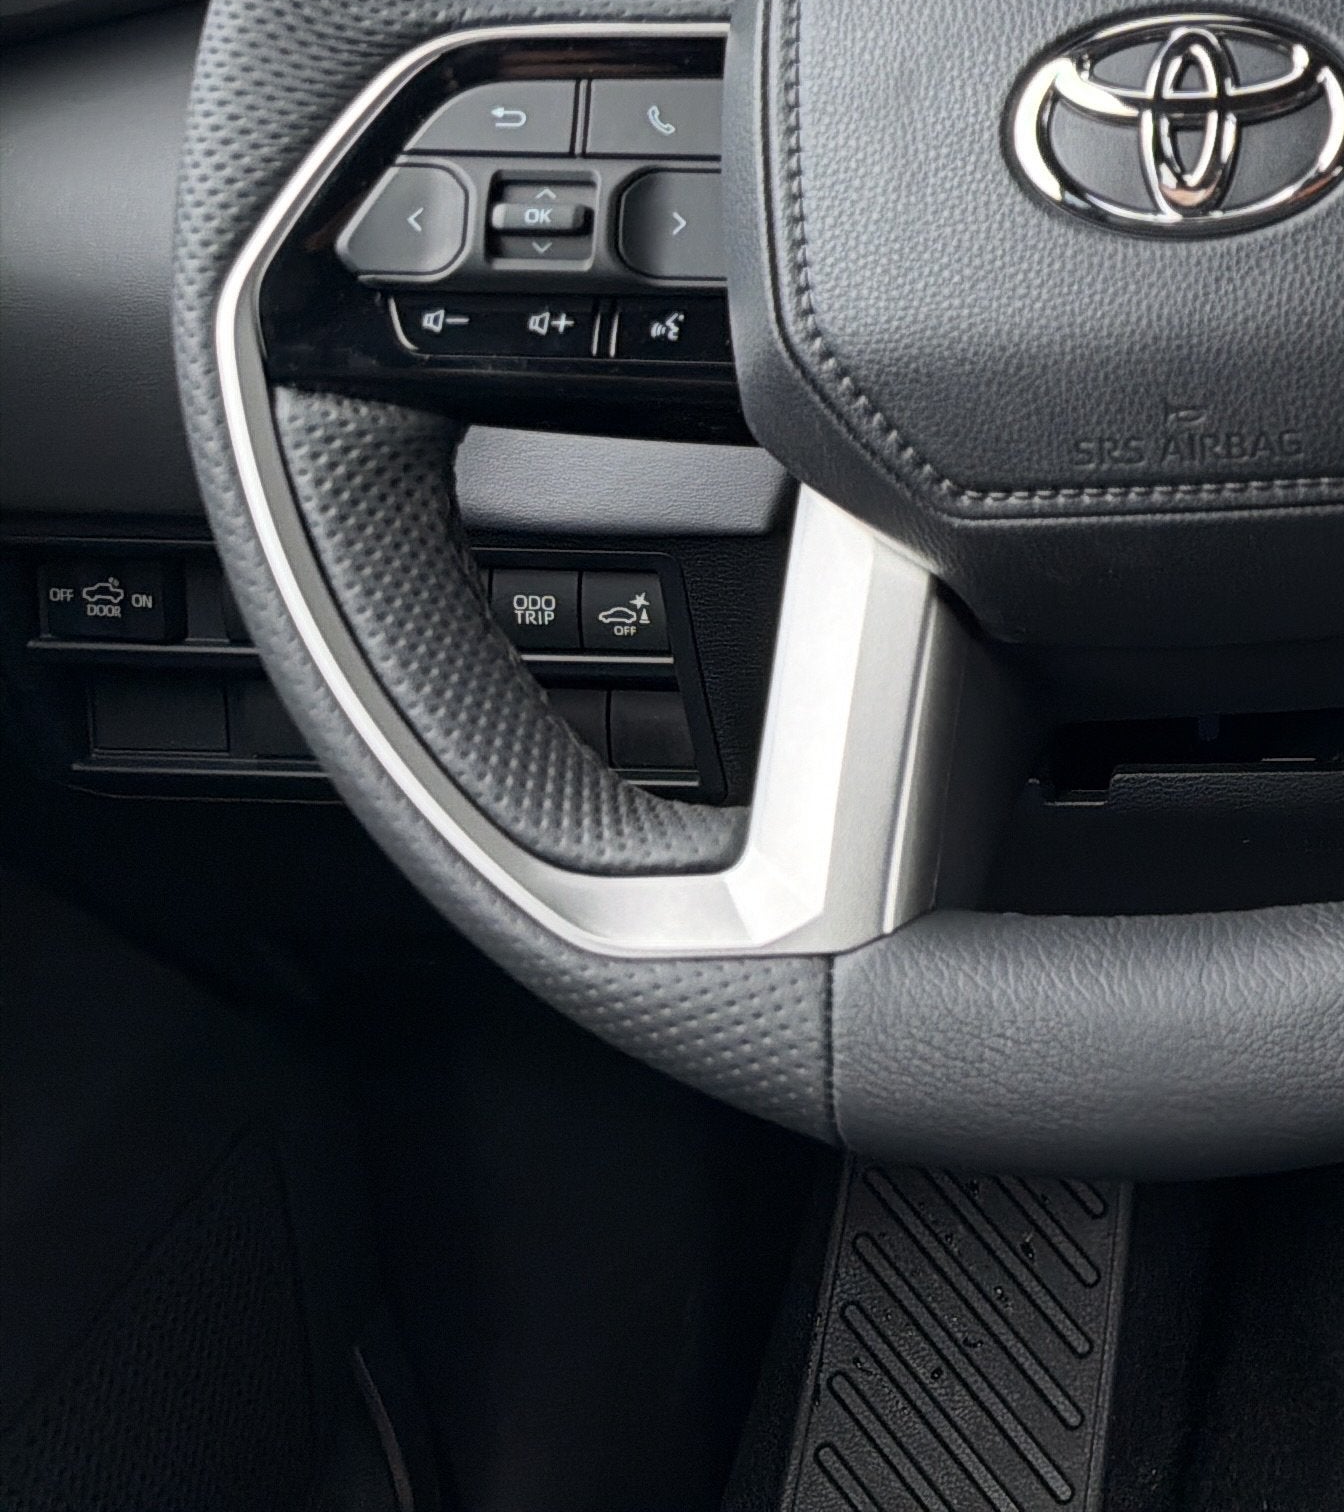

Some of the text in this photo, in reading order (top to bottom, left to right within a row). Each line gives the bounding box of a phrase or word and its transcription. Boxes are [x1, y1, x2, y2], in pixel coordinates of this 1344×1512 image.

[523, 208, 552, 225] OK
[1073, 430, 1304, 468] SRS AIRBAG
[48, 587, 75, 603] OFF
[130, 593, 153, 609] ON
[513, 594, 557, 610] ODO
[86, 604, 122, 618] DOOR
[513, 609, 555, 626] TRIP
[612, 624, 638, 637] OFF
